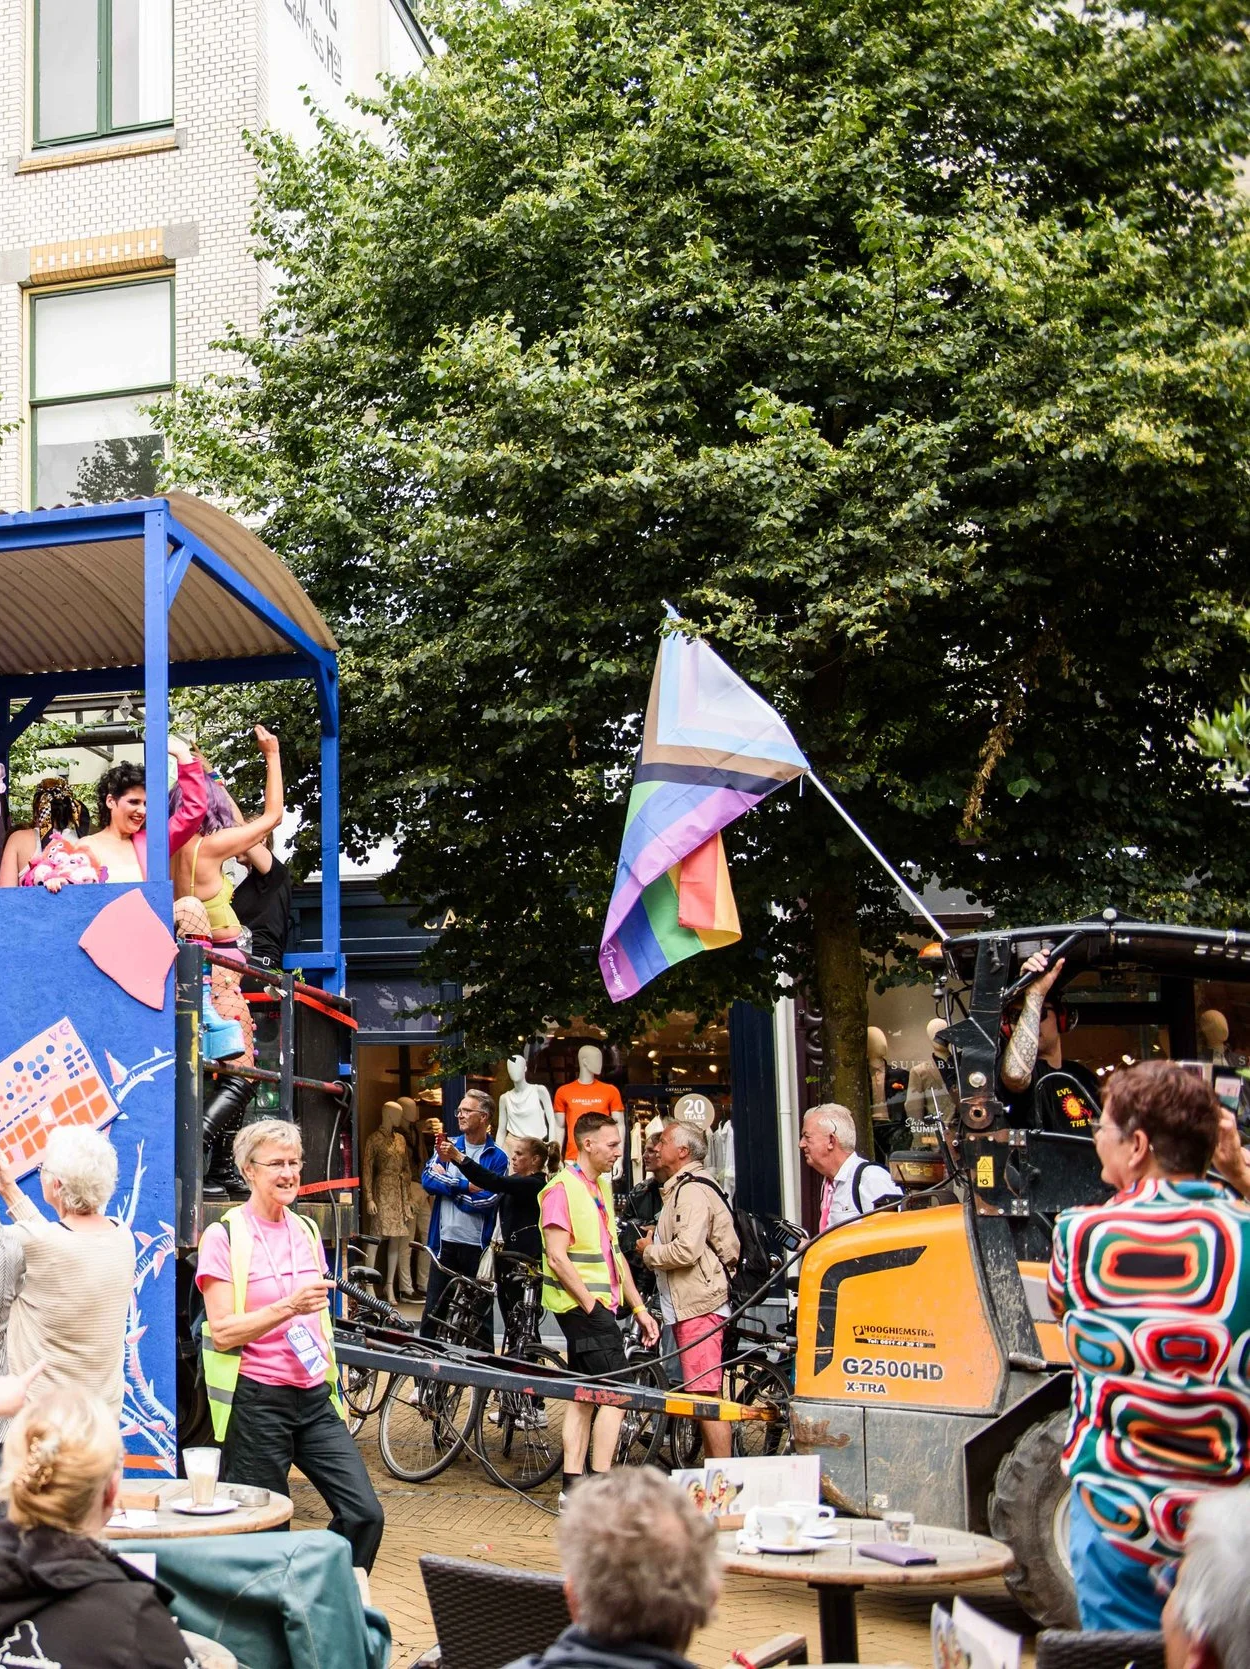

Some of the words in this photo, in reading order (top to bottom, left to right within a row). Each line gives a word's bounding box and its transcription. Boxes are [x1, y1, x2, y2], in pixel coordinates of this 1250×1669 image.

[683, 1099, 706, 1115] 20
[863, 1326, 934, 1337] HOOGHIEMSTRA
[842, 1357, 944, 1381] G2500HD
[846, 1381, 887, 1394] X-TRA
